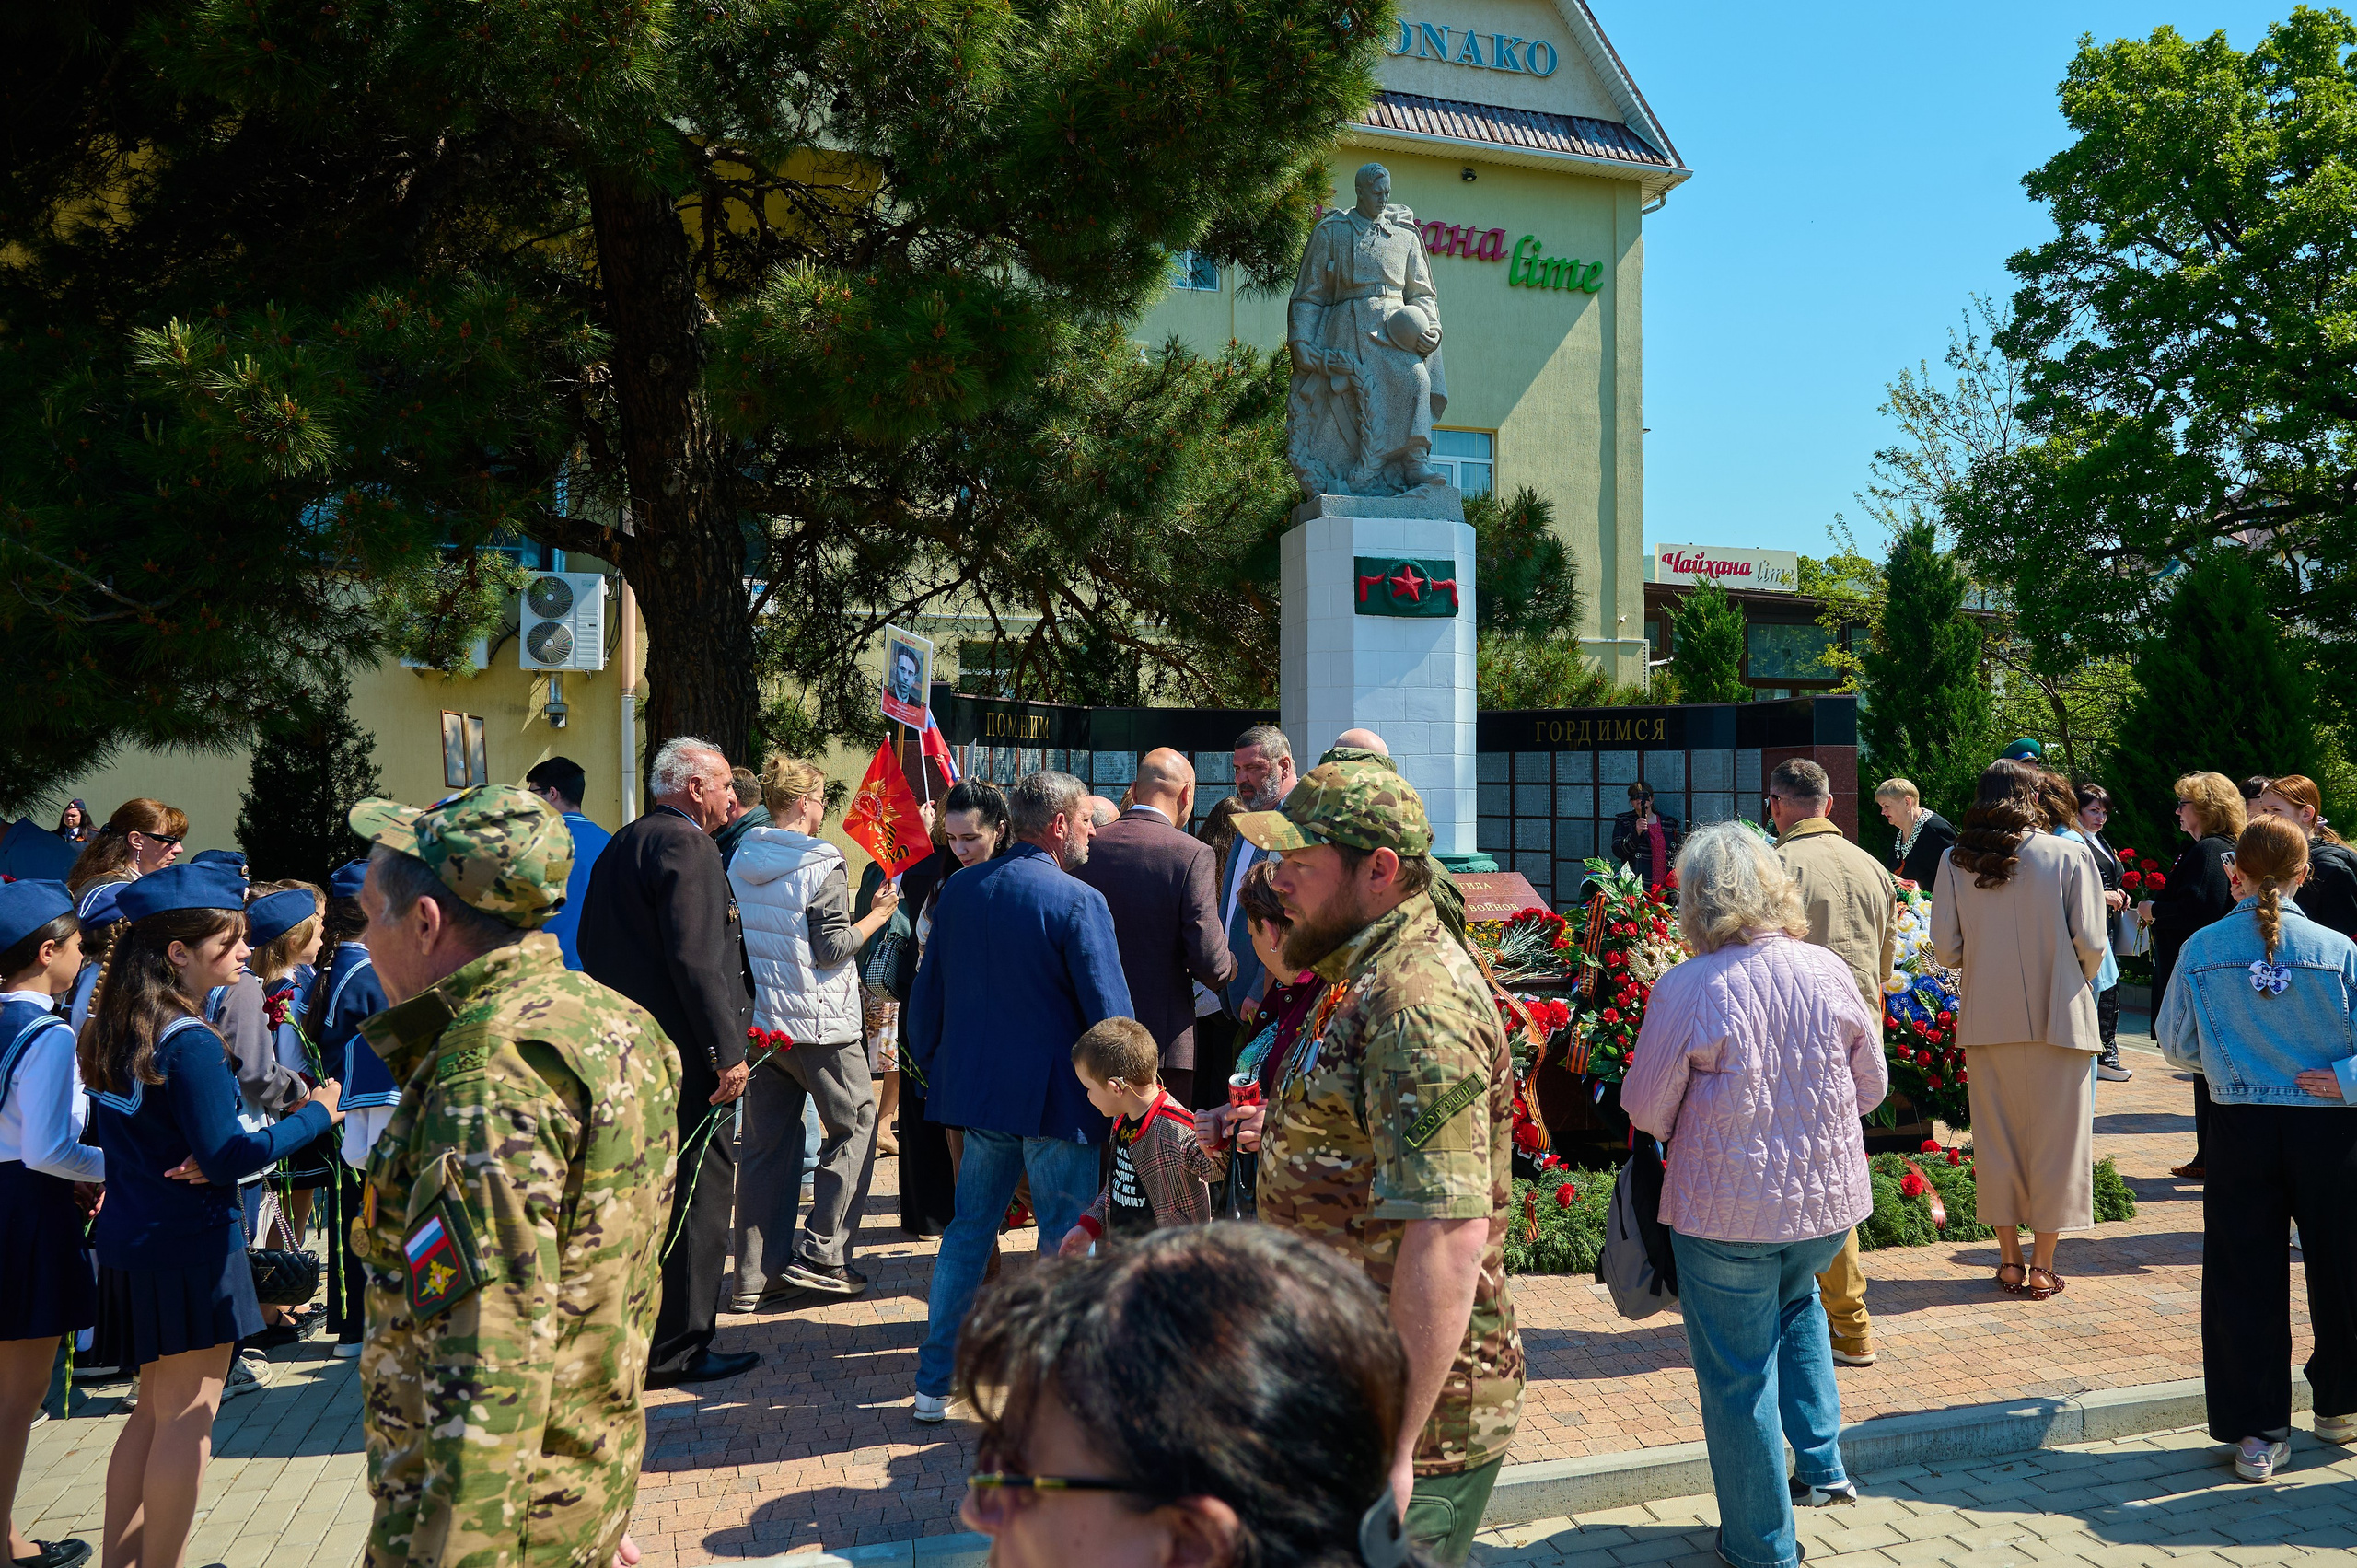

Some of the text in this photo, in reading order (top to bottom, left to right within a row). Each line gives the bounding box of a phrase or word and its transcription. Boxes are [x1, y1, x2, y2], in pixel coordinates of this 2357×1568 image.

[1387, 17, 1558, 77] ONAKO
[1509, 234, 1604, 294] lime
[1661, 550, 1752, 579] Чайхана
[985, 712, 1050, 739] ПОМНИМ
[1535, 718, 1666, 747] ГОРДИМСЯ
[1419, 1084, 1472, 1134] БОРЗЫЙ
[1121, 1183, 1136, 1195] ЖЕ
